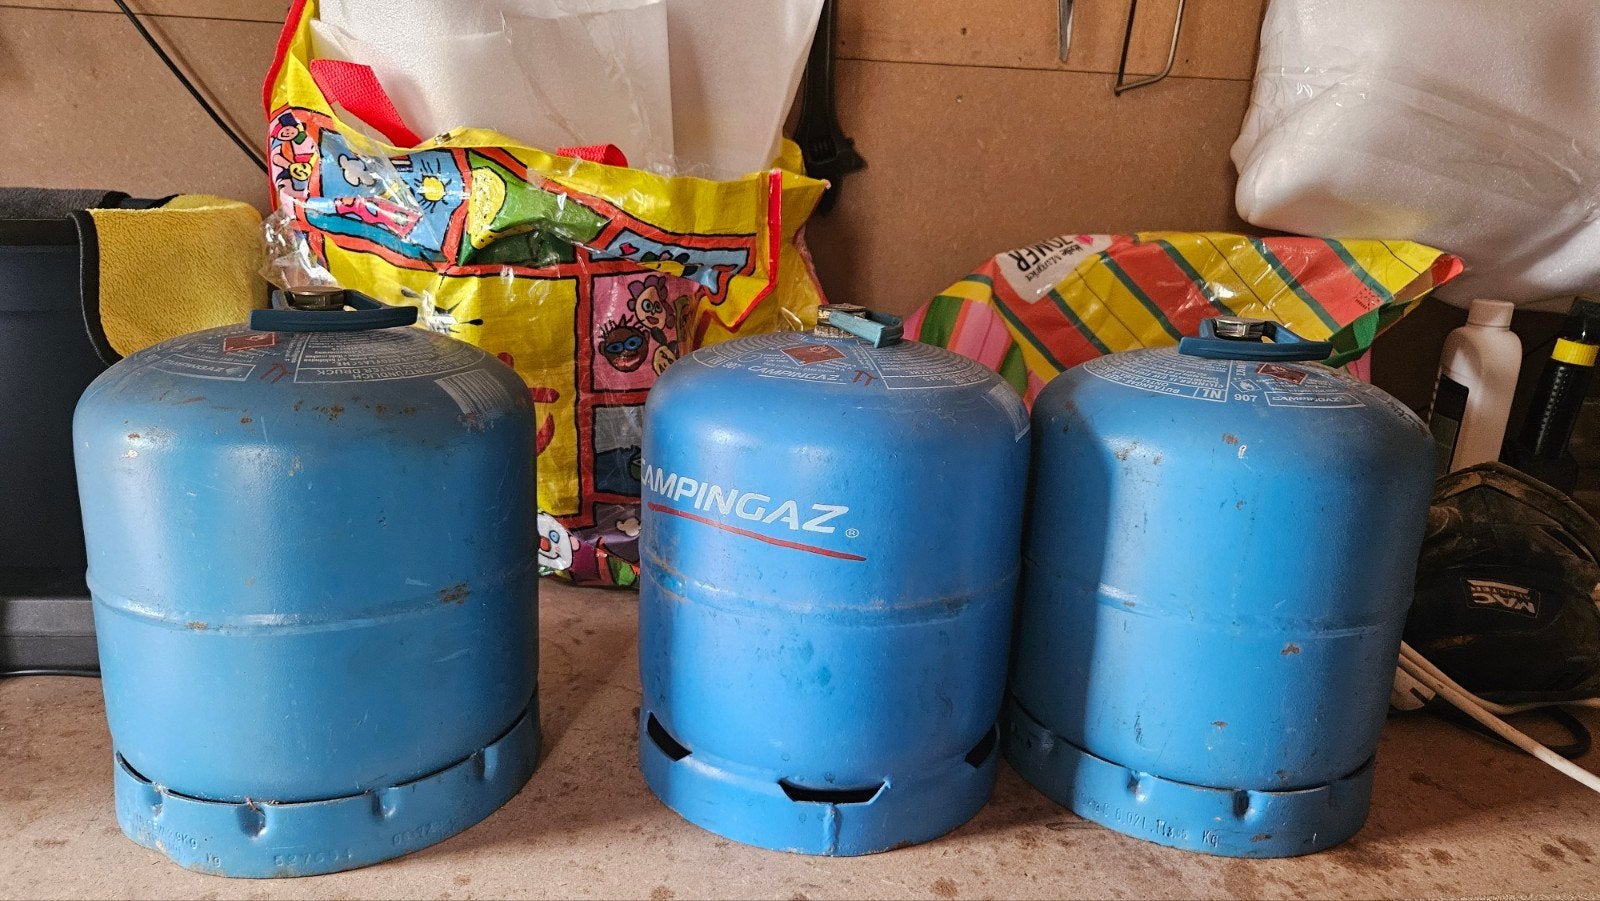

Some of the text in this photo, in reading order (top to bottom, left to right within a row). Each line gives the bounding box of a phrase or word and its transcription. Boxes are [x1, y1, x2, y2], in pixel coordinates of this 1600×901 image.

[747, 366, 841, 381] CAMPINGAZ
[1203, 388, 1221, 399] NL
[1234, 393, 1259, 403] 907
[1472, 593, 1535, 613] MAC
